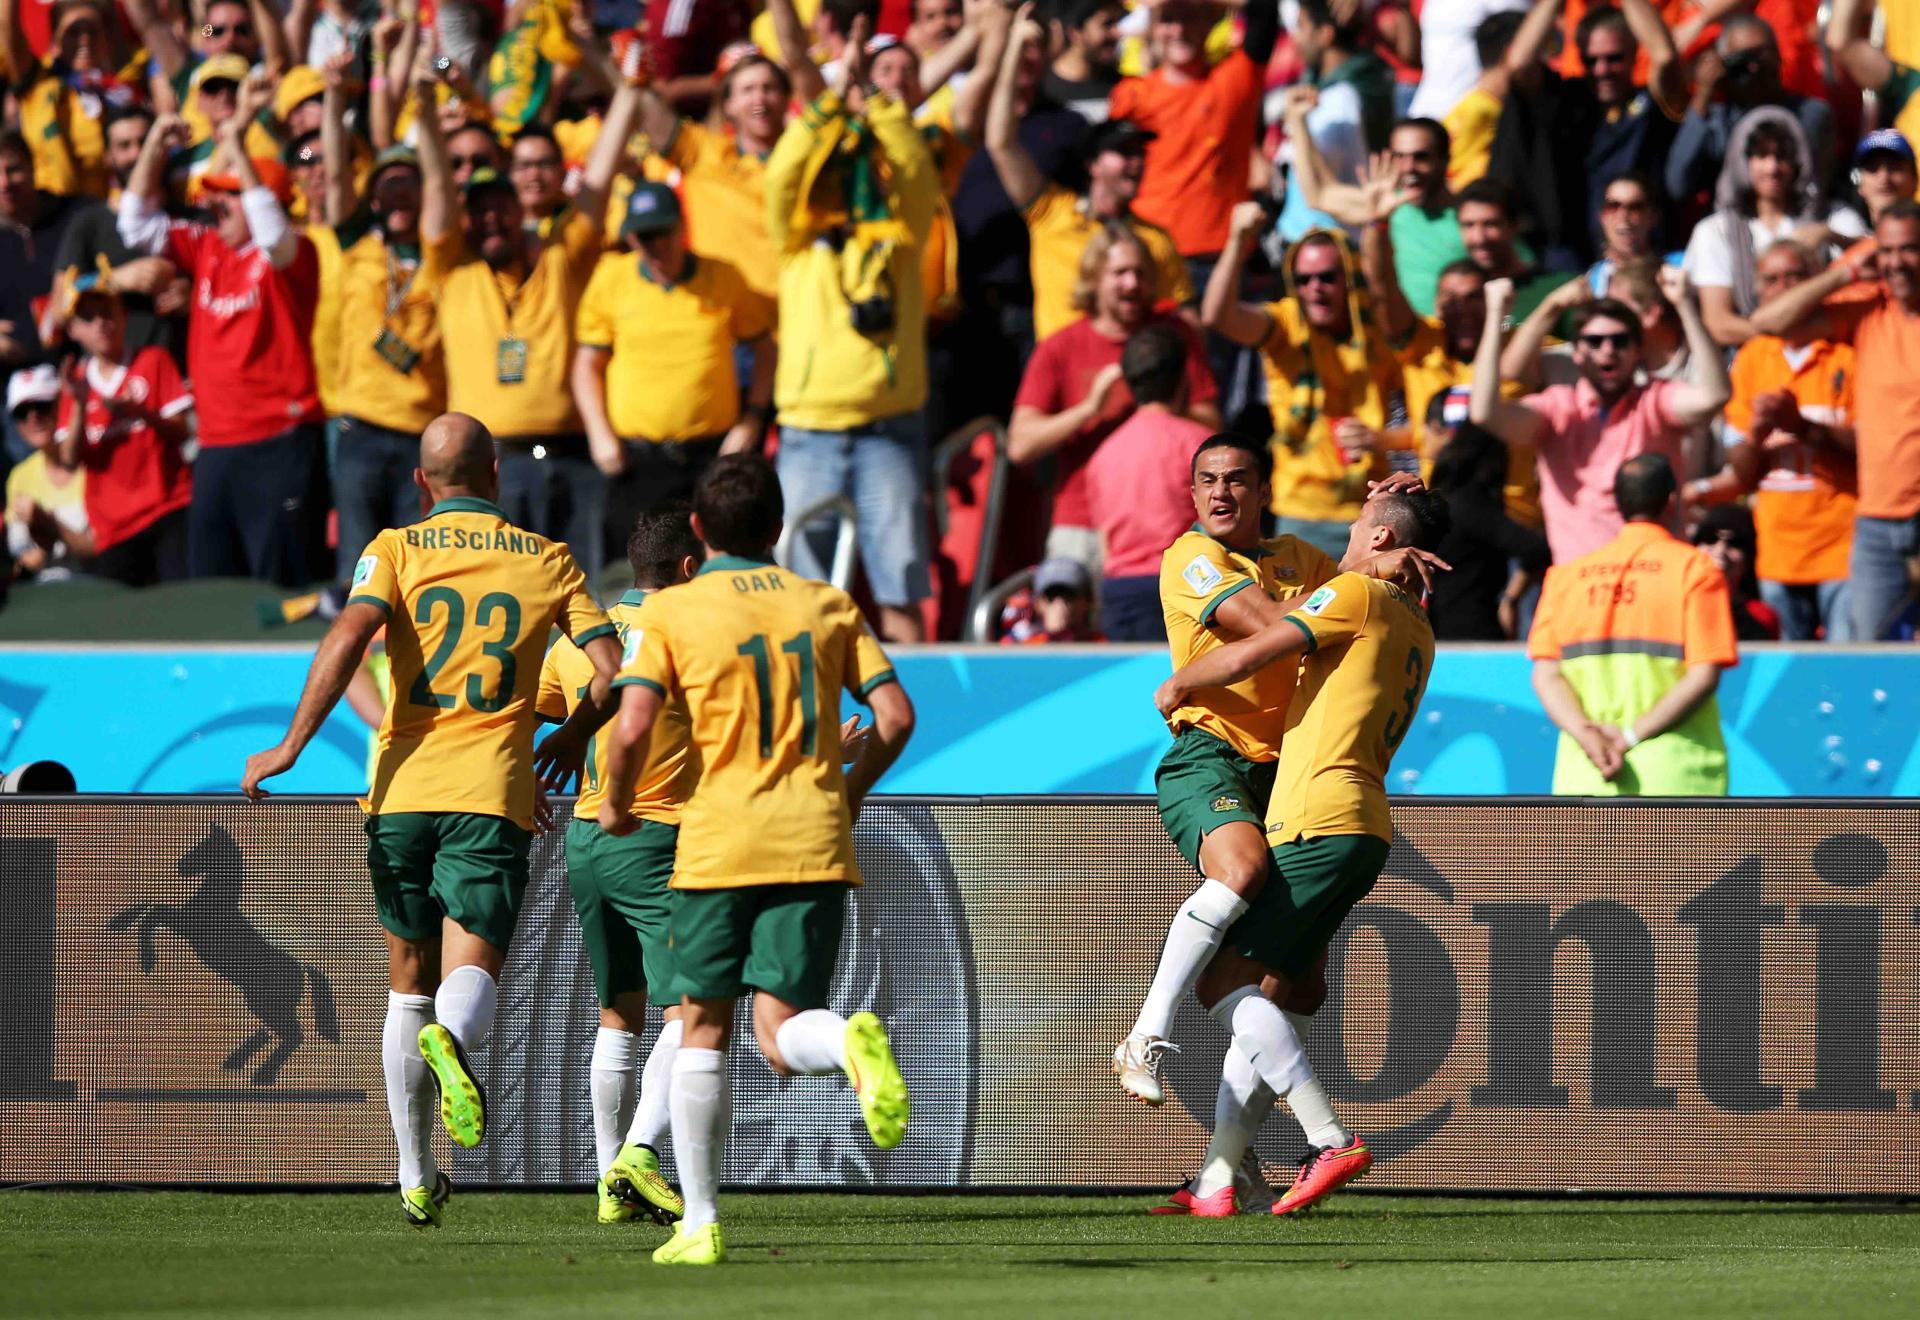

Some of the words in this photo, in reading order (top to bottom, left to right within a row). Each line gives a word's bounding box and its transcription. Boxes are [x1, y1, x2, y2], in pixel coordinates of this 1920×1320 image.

[406, 526, 540, 556] BRESCIANO
[731, 572, 786, 593] OAR
[408, 585, 522, 713] 23
[737, 630, 817, 759] 11
[1383, 645, 1423, 749] 3
